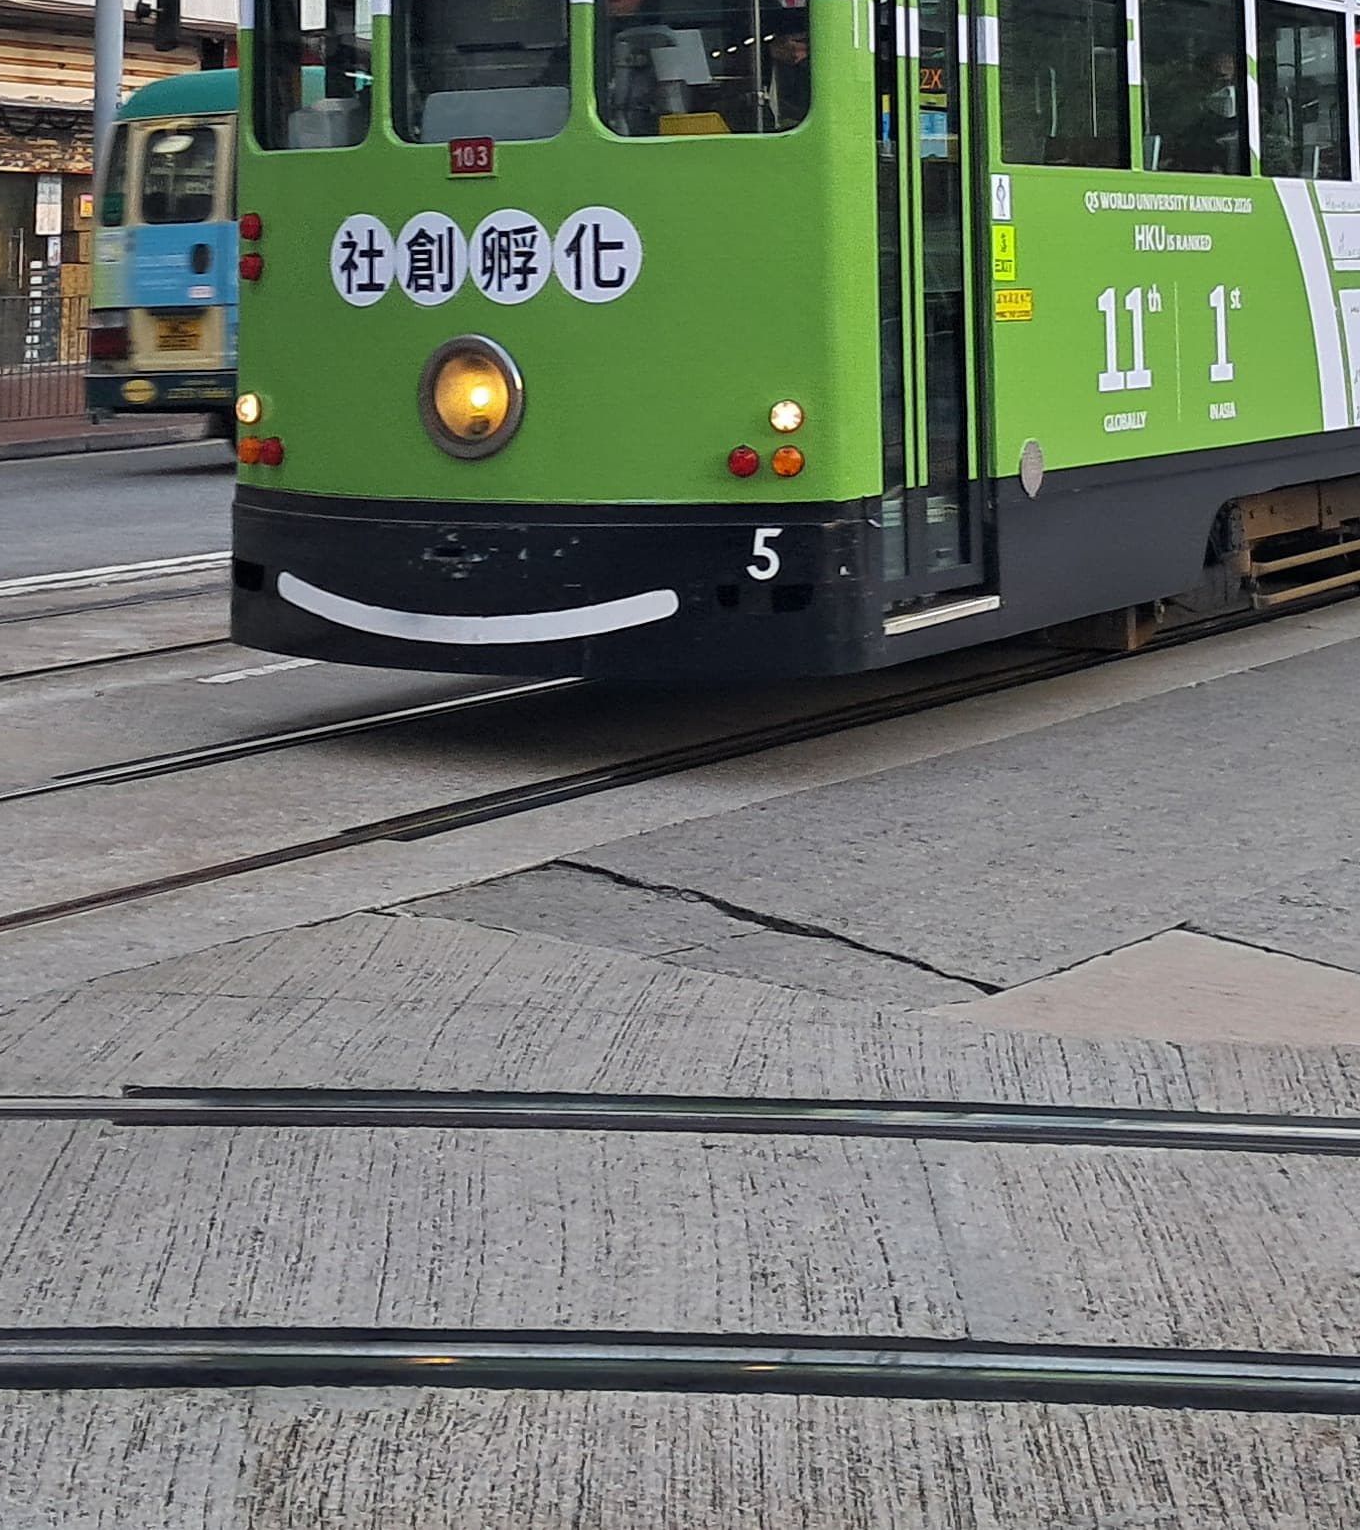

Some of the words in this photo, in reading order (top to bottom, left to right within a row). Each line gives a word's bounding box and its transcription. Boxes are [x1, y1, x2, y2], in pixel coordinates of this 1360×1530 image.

[920, 69, 943, 89] 2X
[453, 146, 488, 167] 103
[1100, 191, 1136, 210] WORLD
[1136, 193, 1189, 211] UNIVERSITY
[1134, 224, 1165, 251] HKU
[1166, 235, 1176, 251] IS
[1176, 234, 1212, 251] RANKED
[340, 223, 626, 294] 社創孵化
[1104, 411, 1148, 433] GLOBALLY
[746, 528, 783, 580] 5
